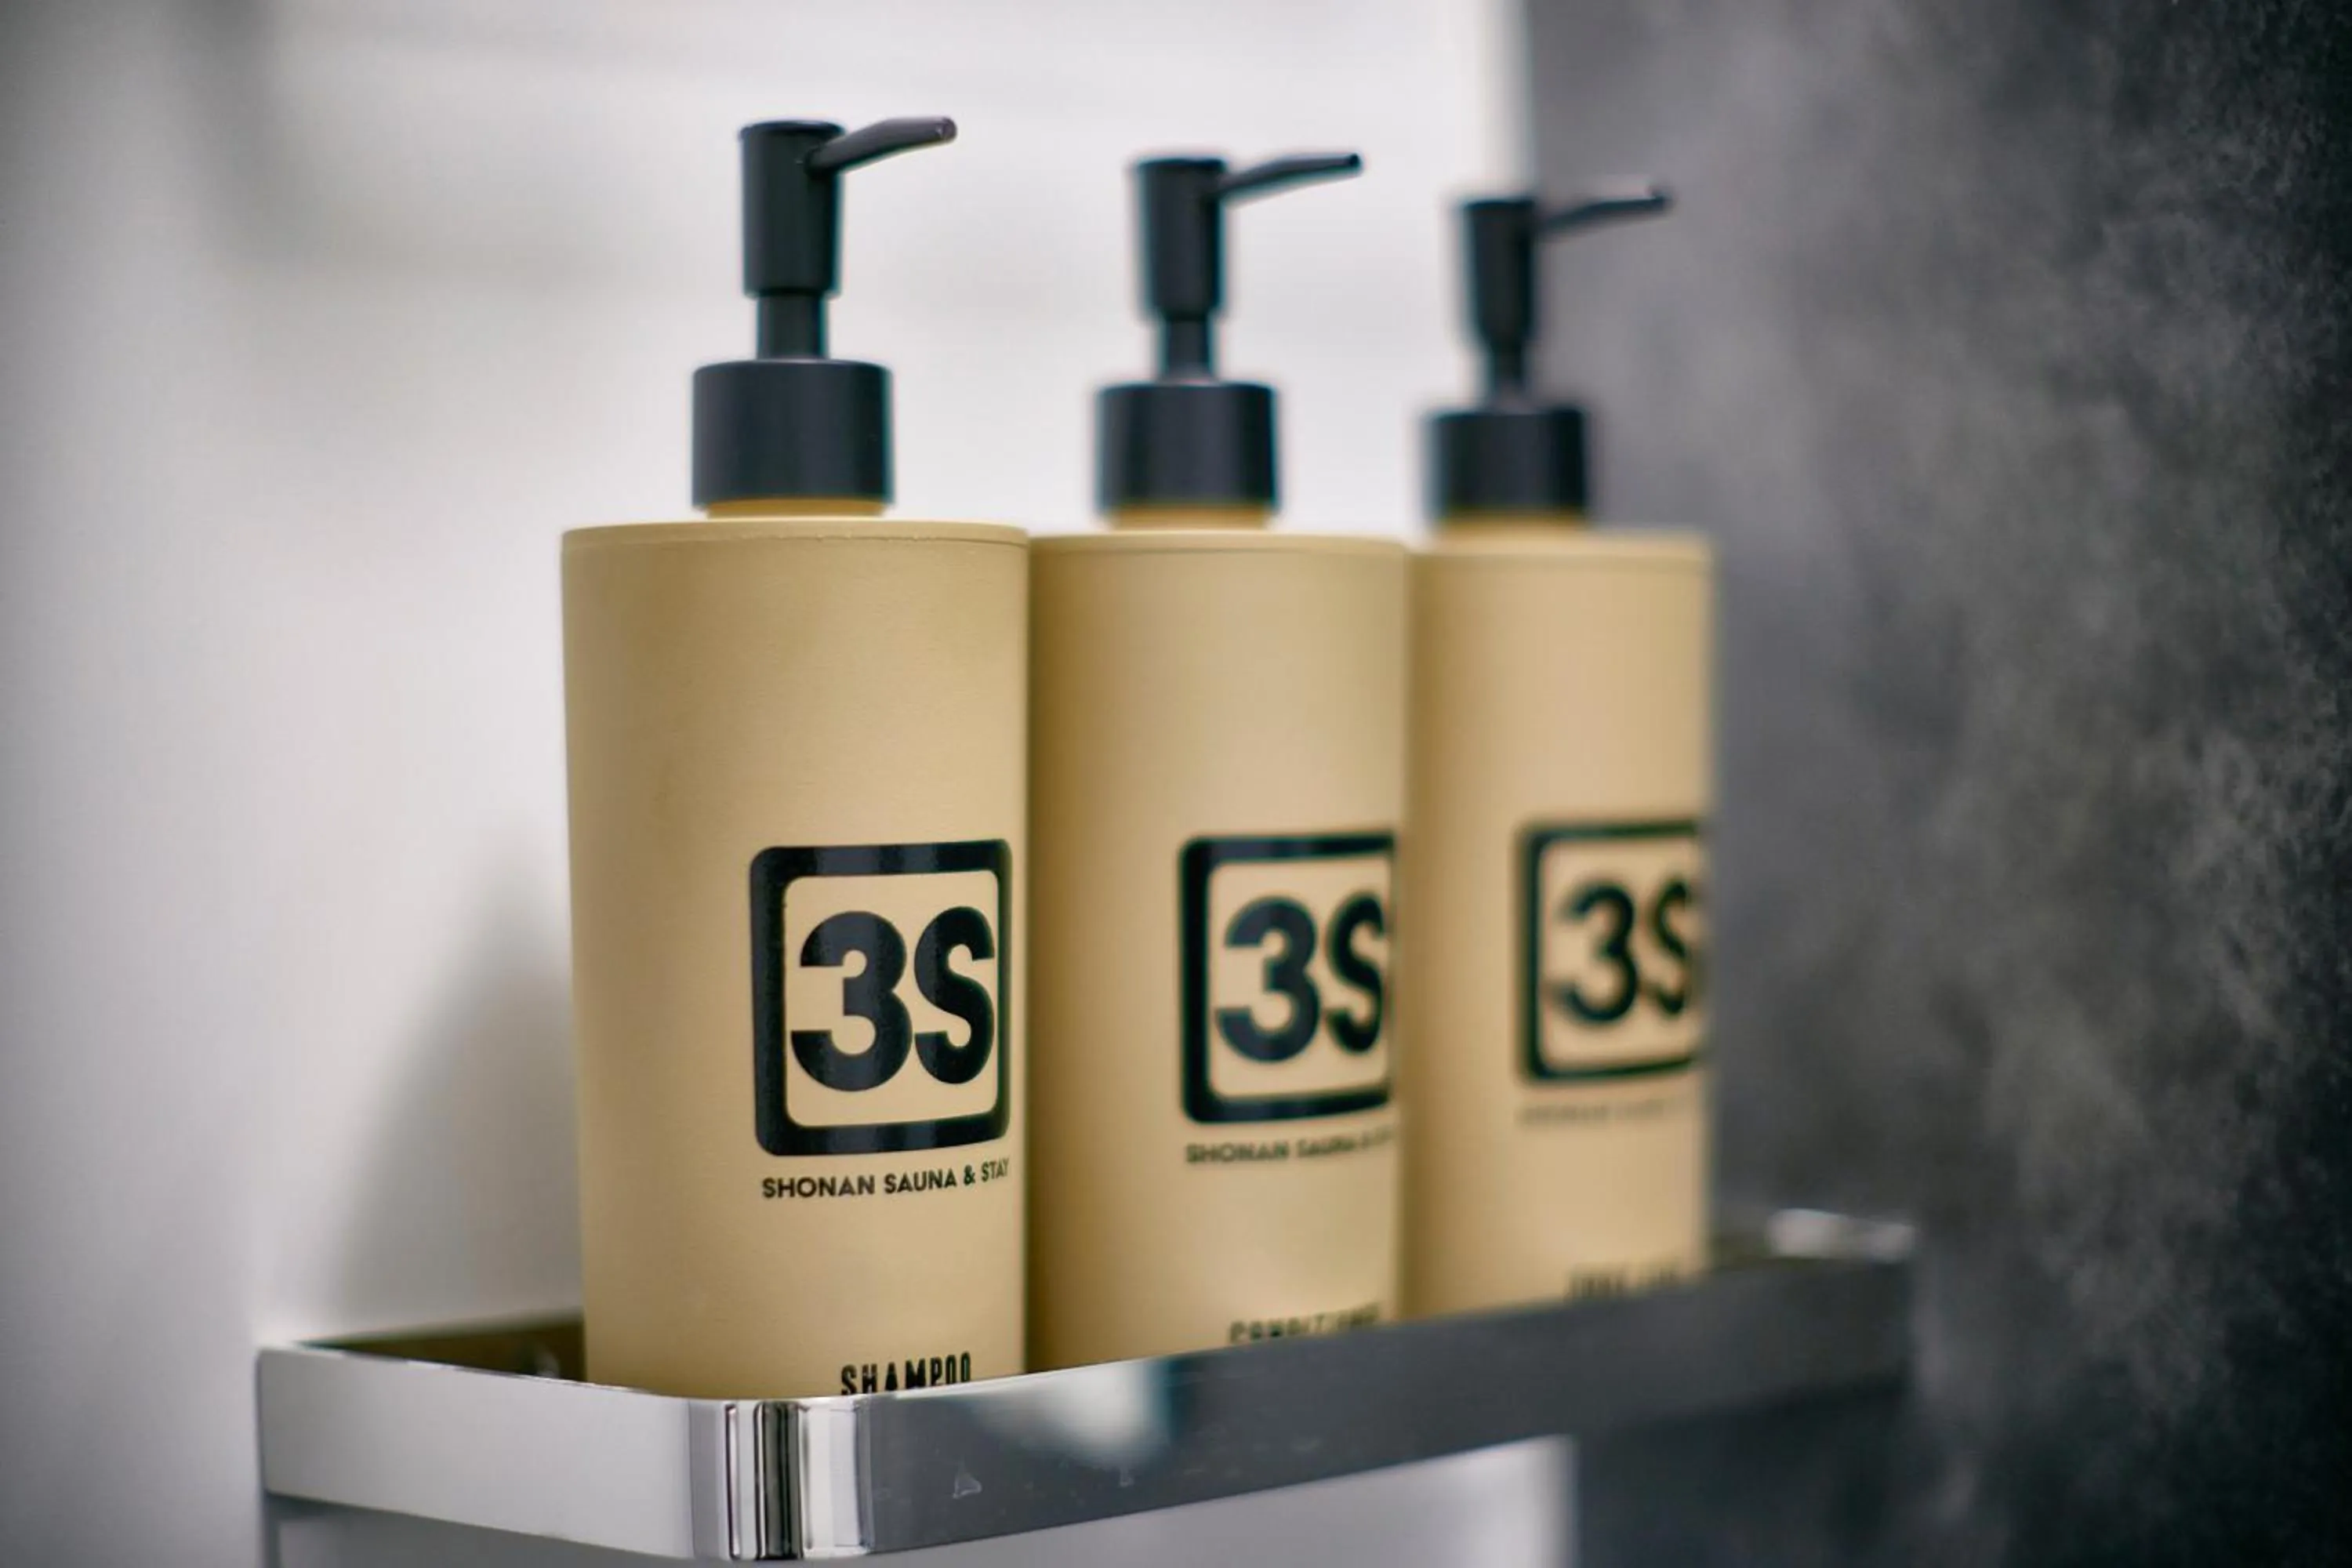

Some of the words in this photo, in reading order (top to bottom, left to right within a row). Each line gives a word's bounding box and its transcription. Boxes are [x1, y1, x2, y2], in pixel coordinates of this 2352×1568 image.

[790, 906, 995, 1092] 3S
[1215, 890, 1386, 1064] 3S
[762, 1174, 876, 1198] SHONAN
[884, 1168, 957, 1193] SAUNA
[963, 1164, 976, 1185] &
[982, 1157, 1010, 1181] STAY
[840, 1351, 971, 1396] SHAMPOO
